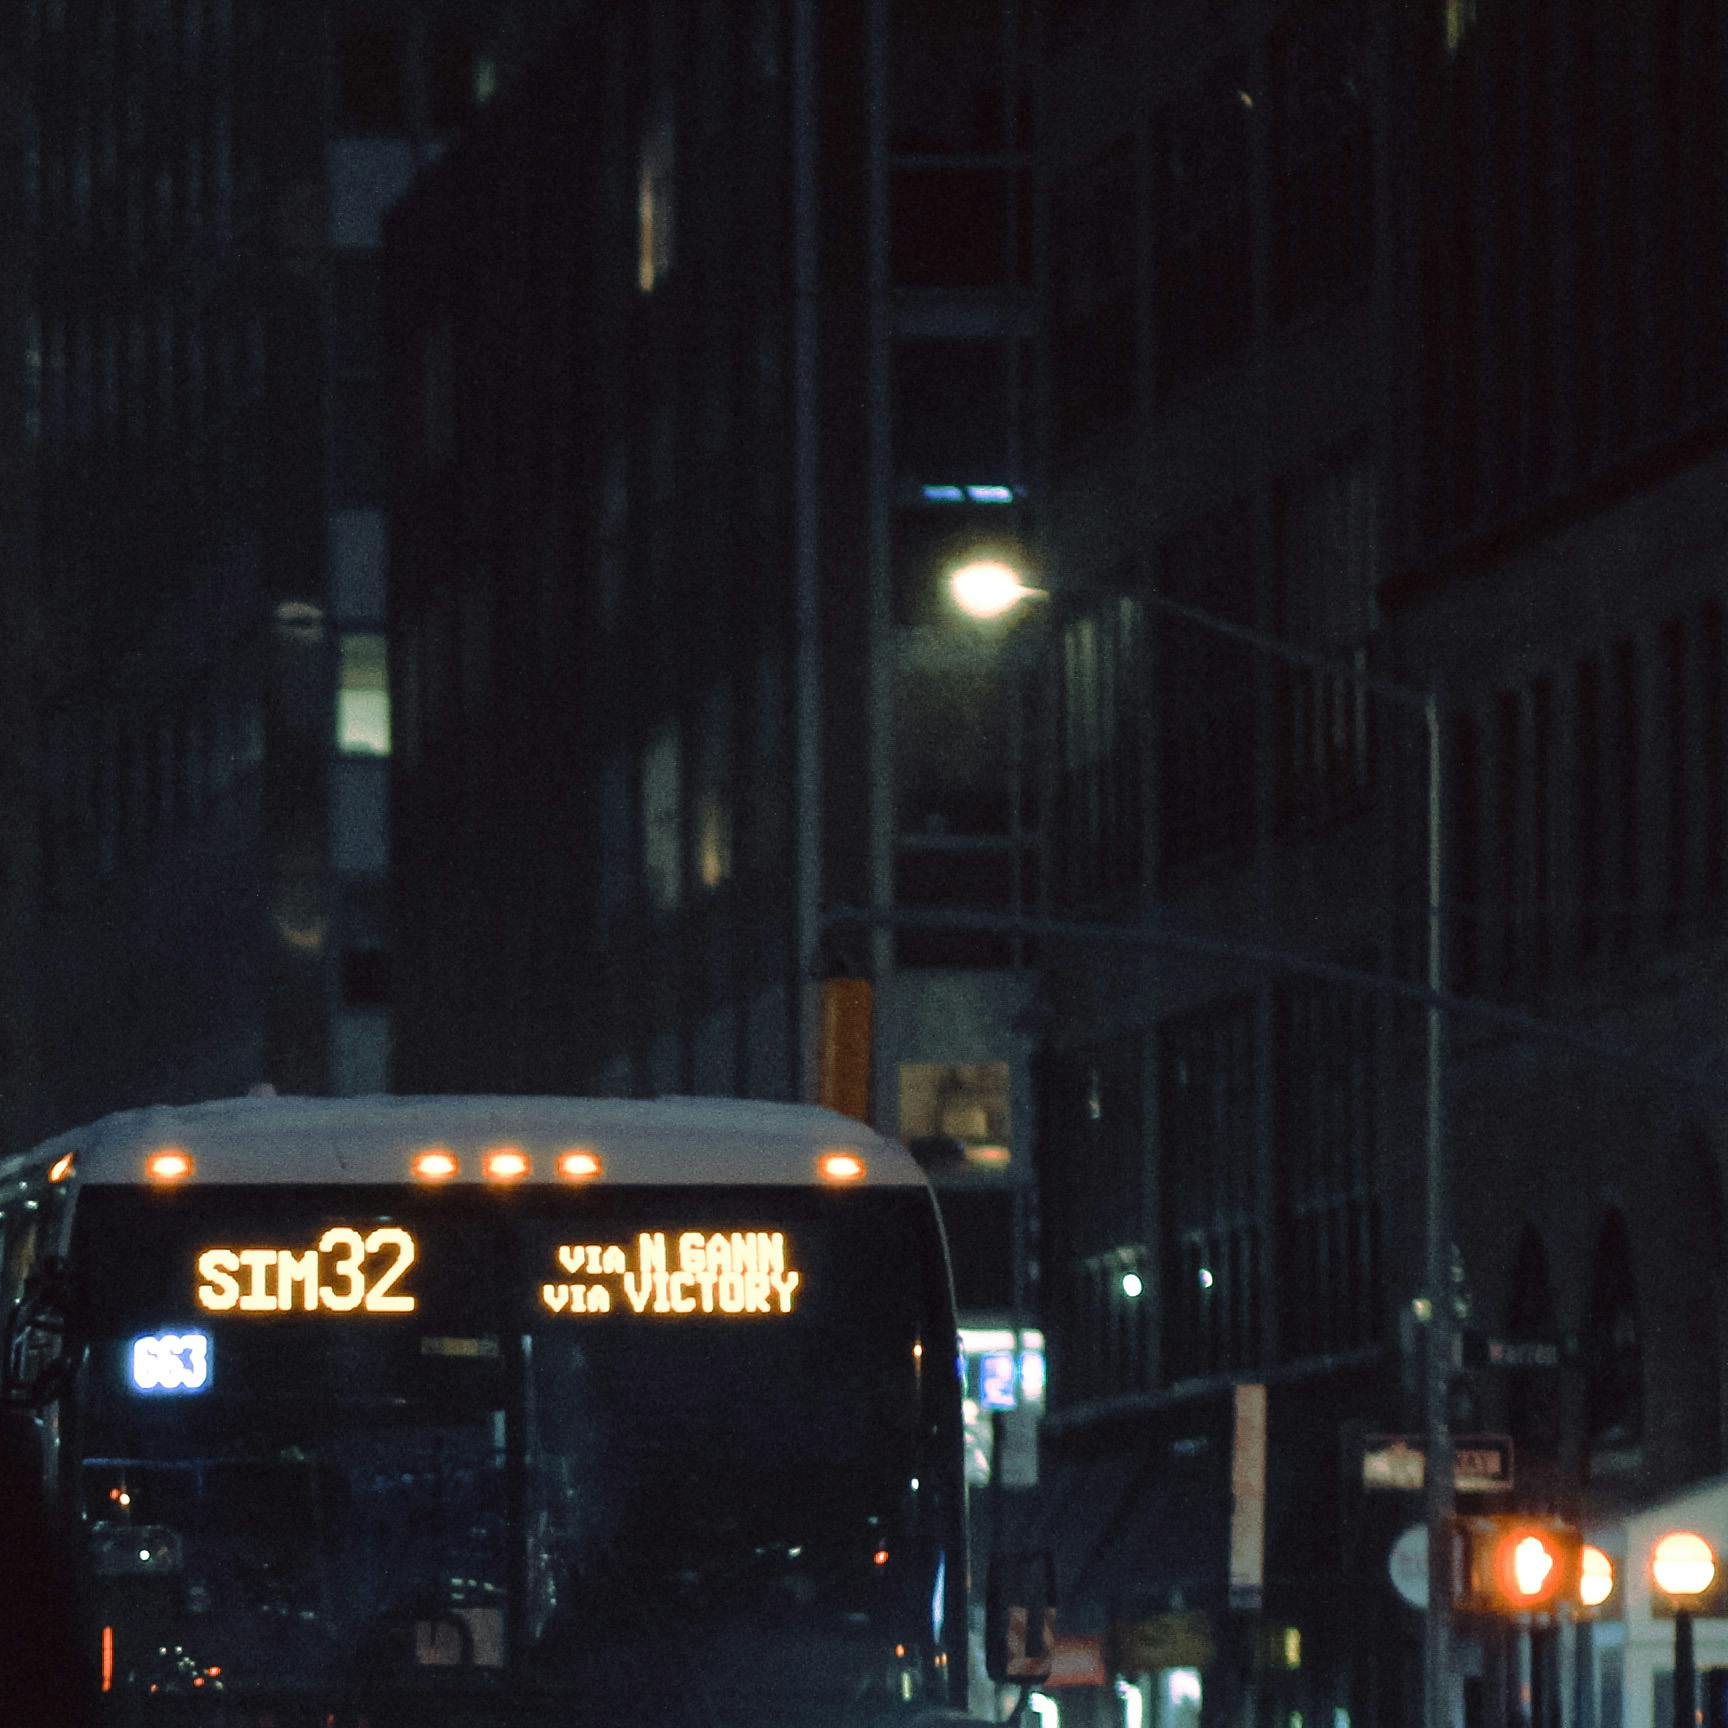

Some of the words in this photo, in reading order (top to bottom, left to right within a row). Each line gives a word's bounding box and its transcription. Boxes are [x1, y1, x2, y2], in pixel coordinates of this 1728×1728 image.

[198, 1227, 415, 1312] SIM32
[639, 1232, 667, 1273] N
[623, 1271, 799, 1313] VICTORY
